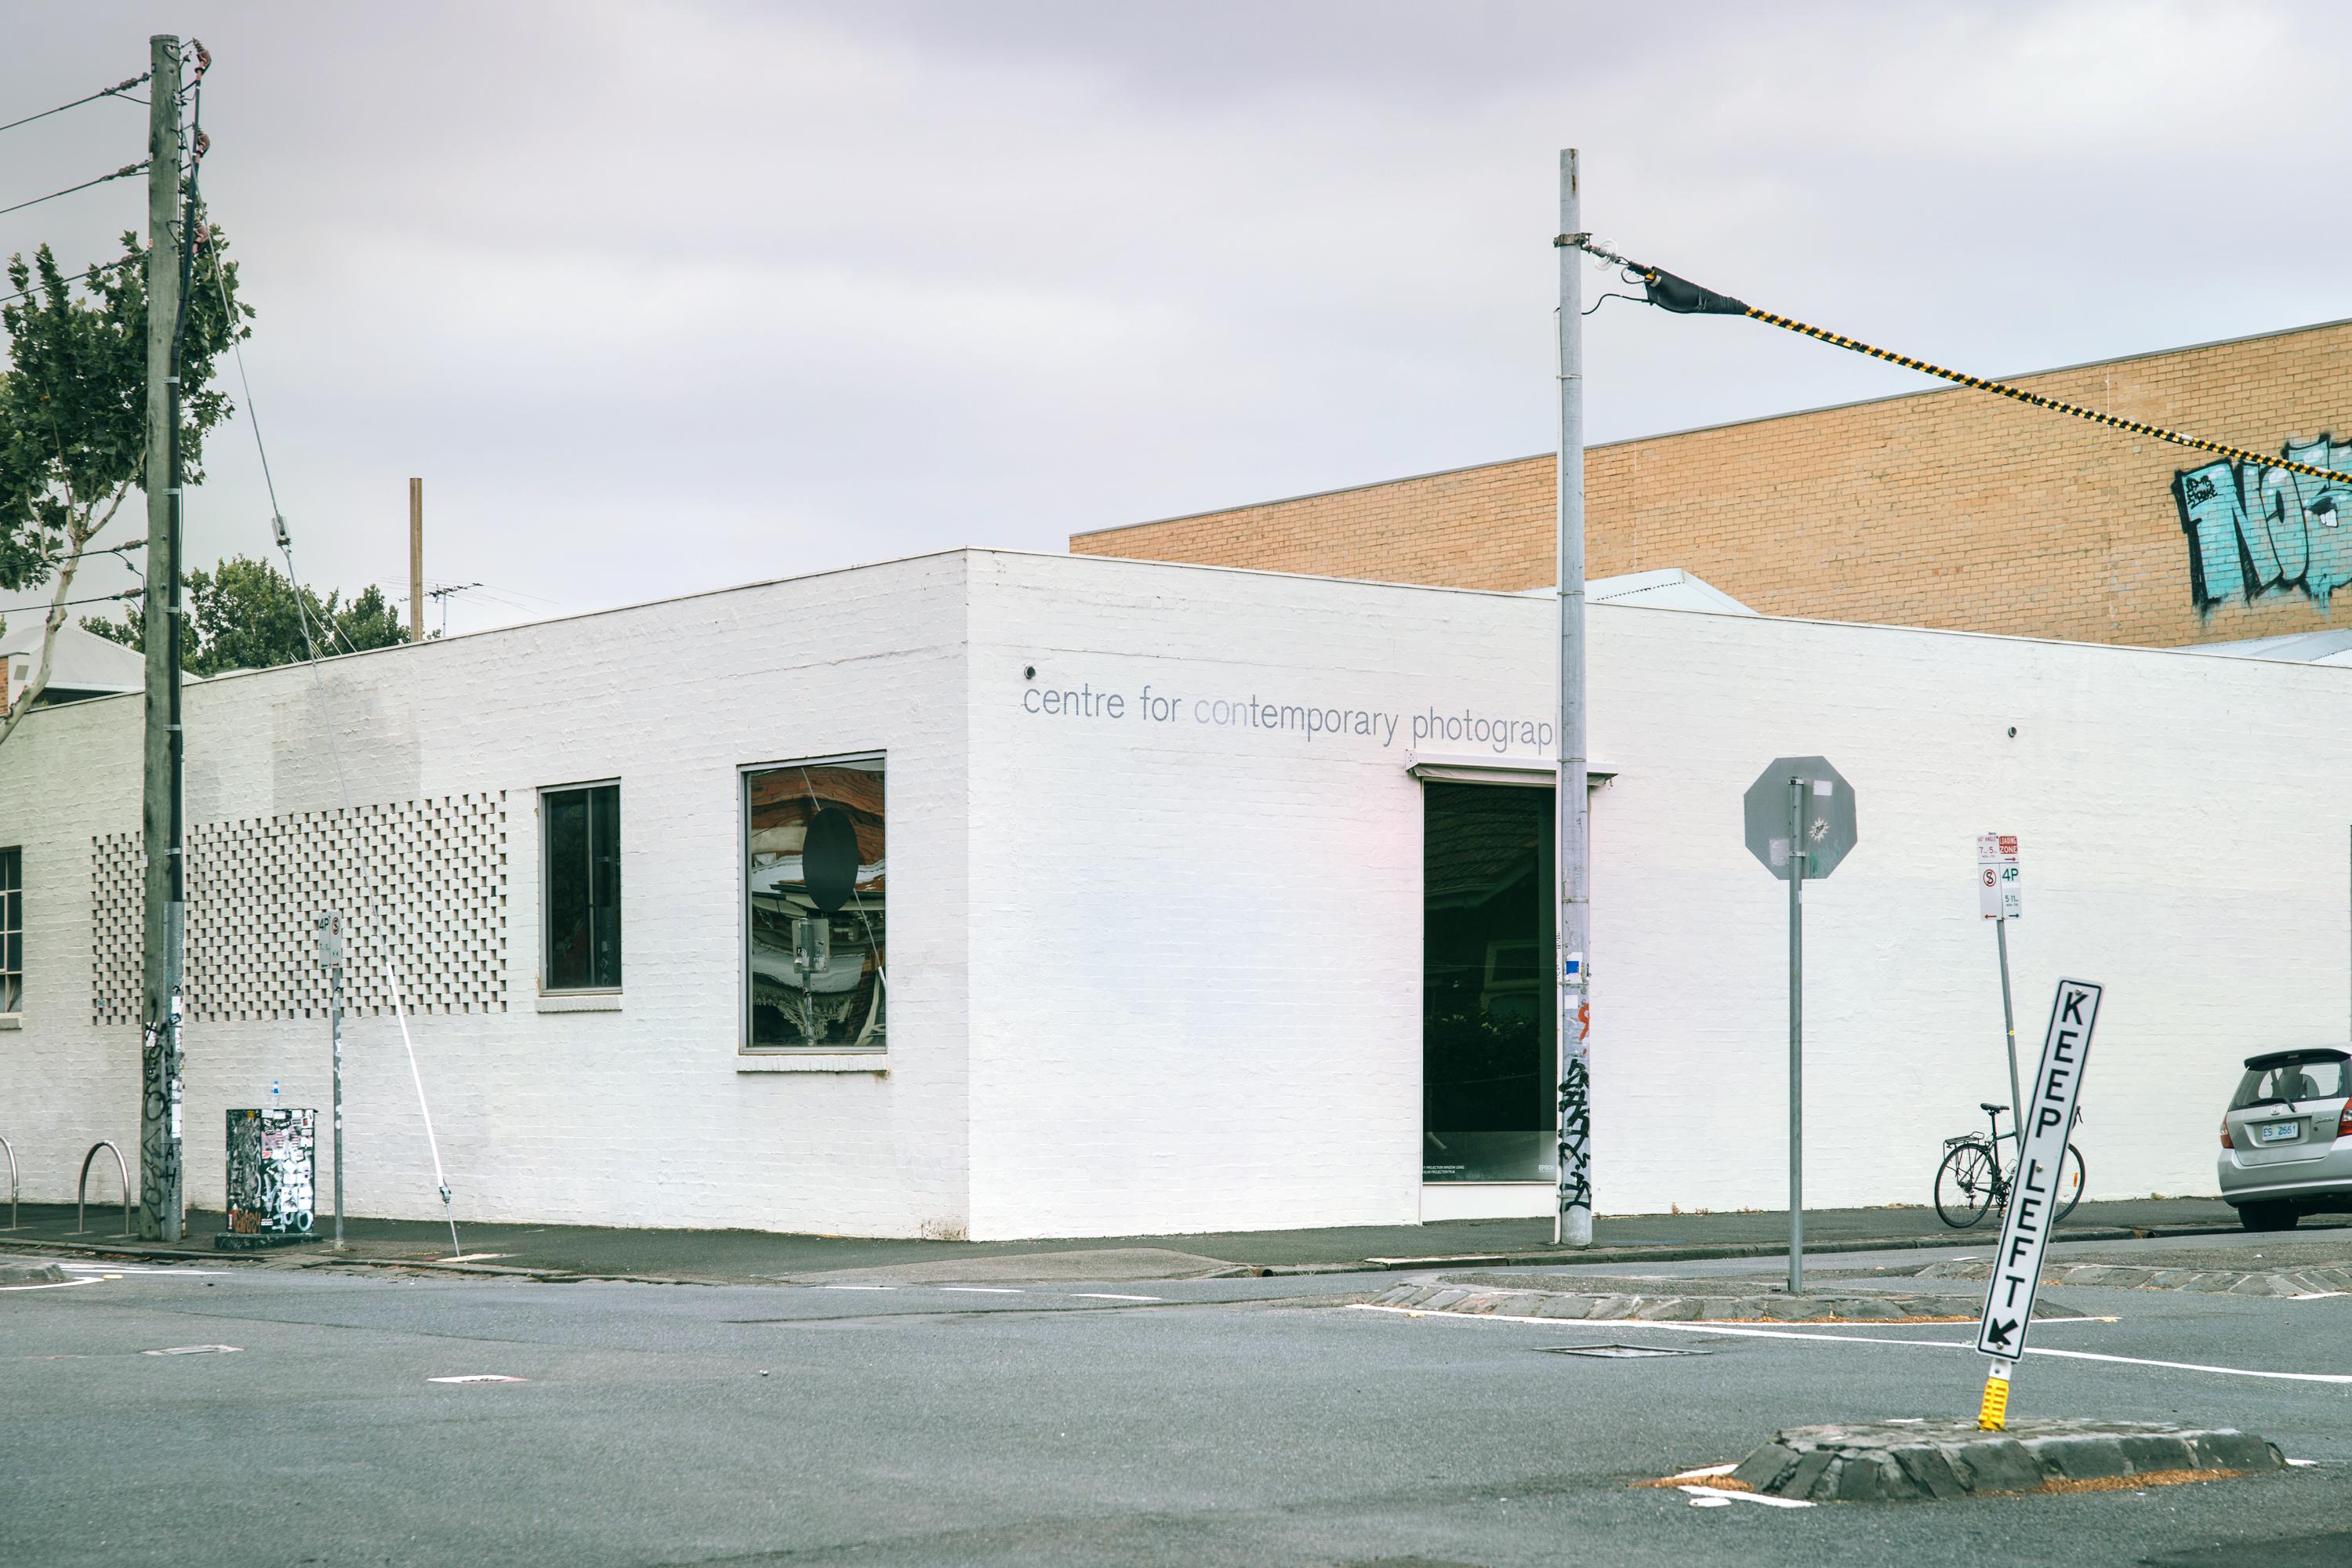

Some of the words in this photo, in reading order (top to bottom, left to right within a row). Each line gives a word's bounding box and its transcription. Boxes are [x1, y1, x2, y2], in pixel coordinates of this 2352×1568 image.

[1024, 683, 1124, 718] centre
[1139, 685, 1181, 721] for
[1194, 694, 1399, 747] contemporary
[1413, 706, 1558, 755] photograp
[2002, 868, 2019, 881] 4P
[319, 917, 329, 931] 4P
[2035, 991, 2089, 1138] KEEP
[2005, 1158, 2045, 1308] LEFT
